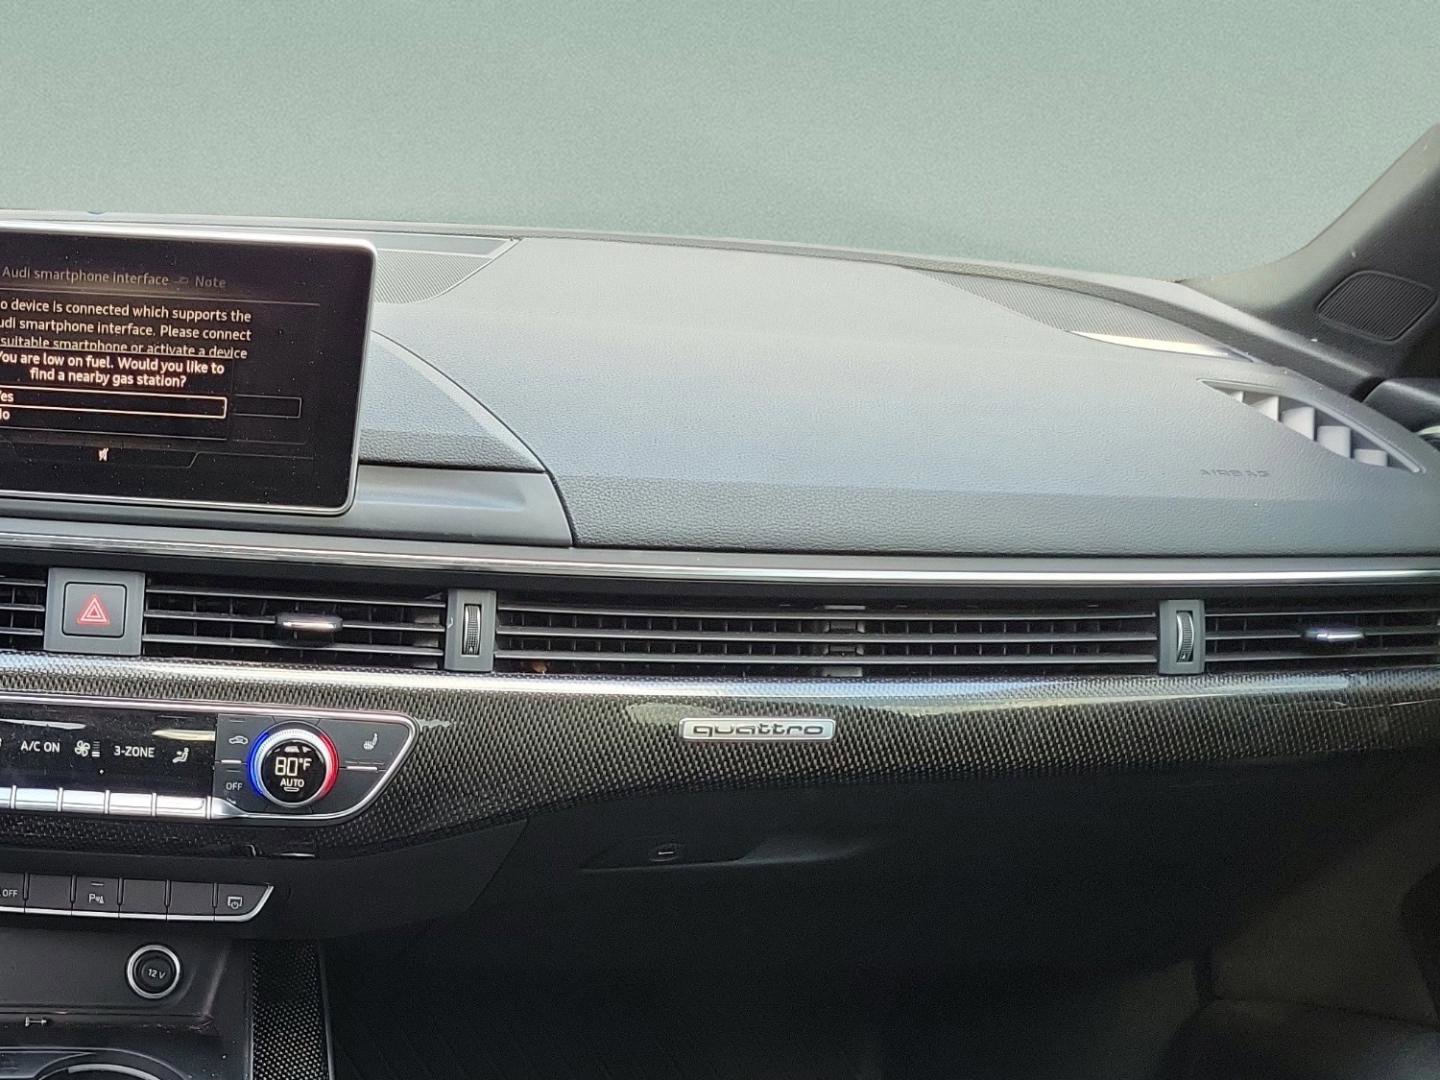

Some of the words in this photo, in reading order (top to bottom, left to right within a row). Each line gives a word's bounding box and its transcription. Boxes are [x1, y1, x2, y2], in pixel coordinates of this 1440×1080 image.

[2, 266, 31, 279] Audi
[34, 269, 109, 284] smartphone
[113, 271, 169, 286] interface
[195, 276, 226, 289] Note
[11, 297, 49, 312] device
[53, 300, 62, 313] is
[65, 301, 130, 317] connected
[132, 305, 169, 319] which
[172, 308, 227, 324] supports
[230, 309, 251, 323] the
[19, 318, 94, 335] smartphone
[98, 320, 156, 337] interface.
[160, 324, 199, 339] Please
[202, 327, 251, 342] connect
[0, 335, 50, 348] suitable
[53, 337, 127, 353] smartphone
[130, 343, 143, 352] or
[146, 341, 195, 357] activate
[208, 345, 248, 359] device
[20, 352, 41, 365] are
[43, 352, 64, 366] low
[67, 356, 83, 367] on
[117, 356, 159, 371] Would
[161, 361, 183, 374] you
[186, 360, 208, 373] like
[211, 362, 225, 374] to
[30, 367, 55, 381] find
[58, 372, 64, 382] a
[68, 369, 110, 386] nearby
[113, 373, 133, 387] gas
[136, 373, 186, 388] station?
[693, 723, 824, 737] quattro
[20, 741, 40, 752] A/C
[44, 742, 61, 753] ON
[114, 745, 155, 758] 3-ZONE
[225, 781, 243, 791] OFF
[280, 778, 305, 788] AUTO
[2, 889, 18, 898] OFF
